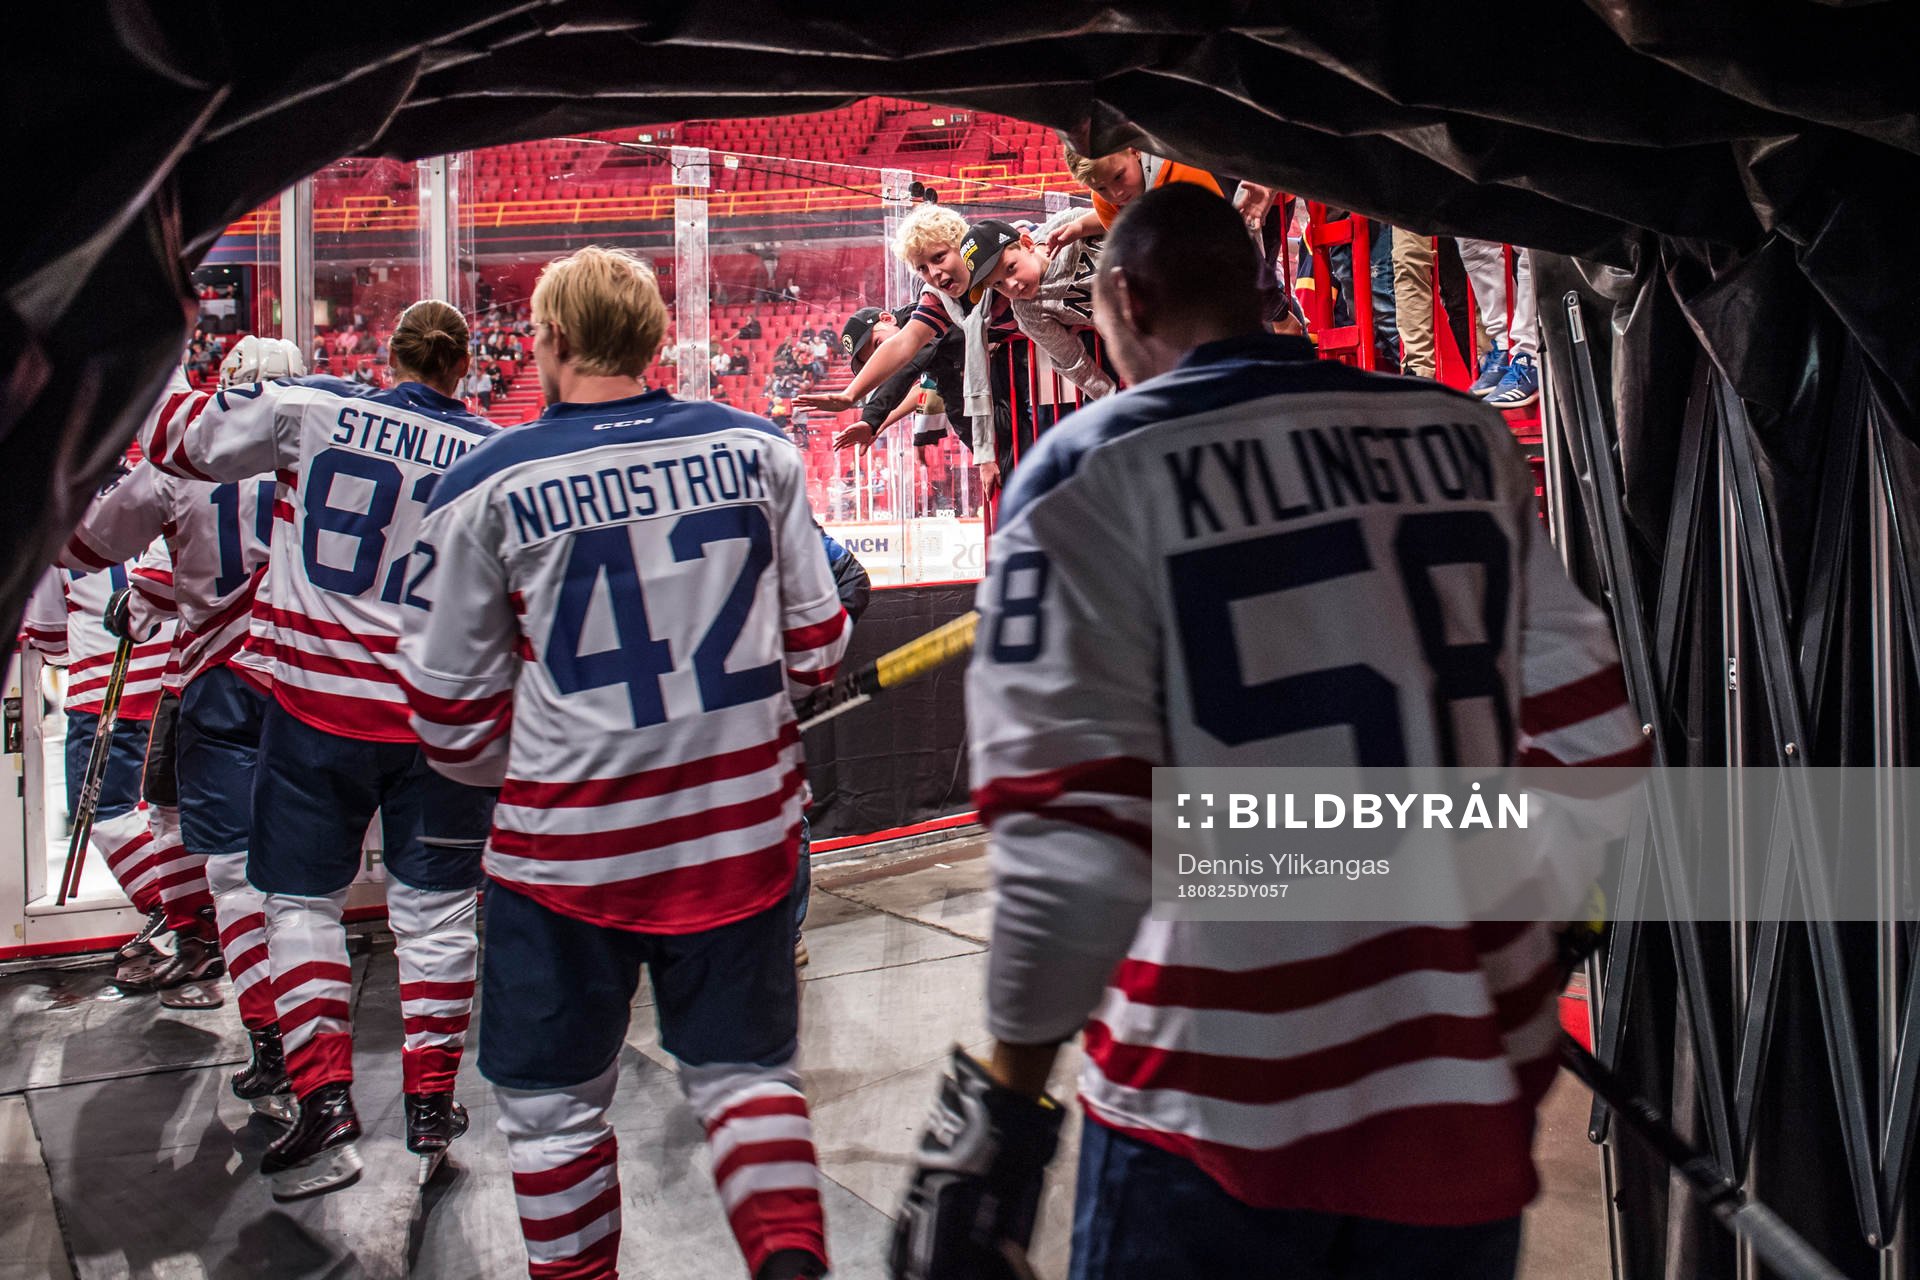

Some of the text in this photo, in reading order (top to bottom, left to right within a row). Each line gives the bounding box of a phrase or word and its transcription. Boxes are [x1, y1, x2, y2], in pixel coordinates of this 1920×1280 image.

[593, 417, 654, 430] CCM
[508, 443, 764, 544] NORDSTRÖM
[1167, 424, 1495, 538] KYLINGTON
[404, 541, 437, 612] 2
[545, 505, 784, 729] 42
[991, 551, 1049, 664] 8
[1167, 510, 1513, 884] 58
